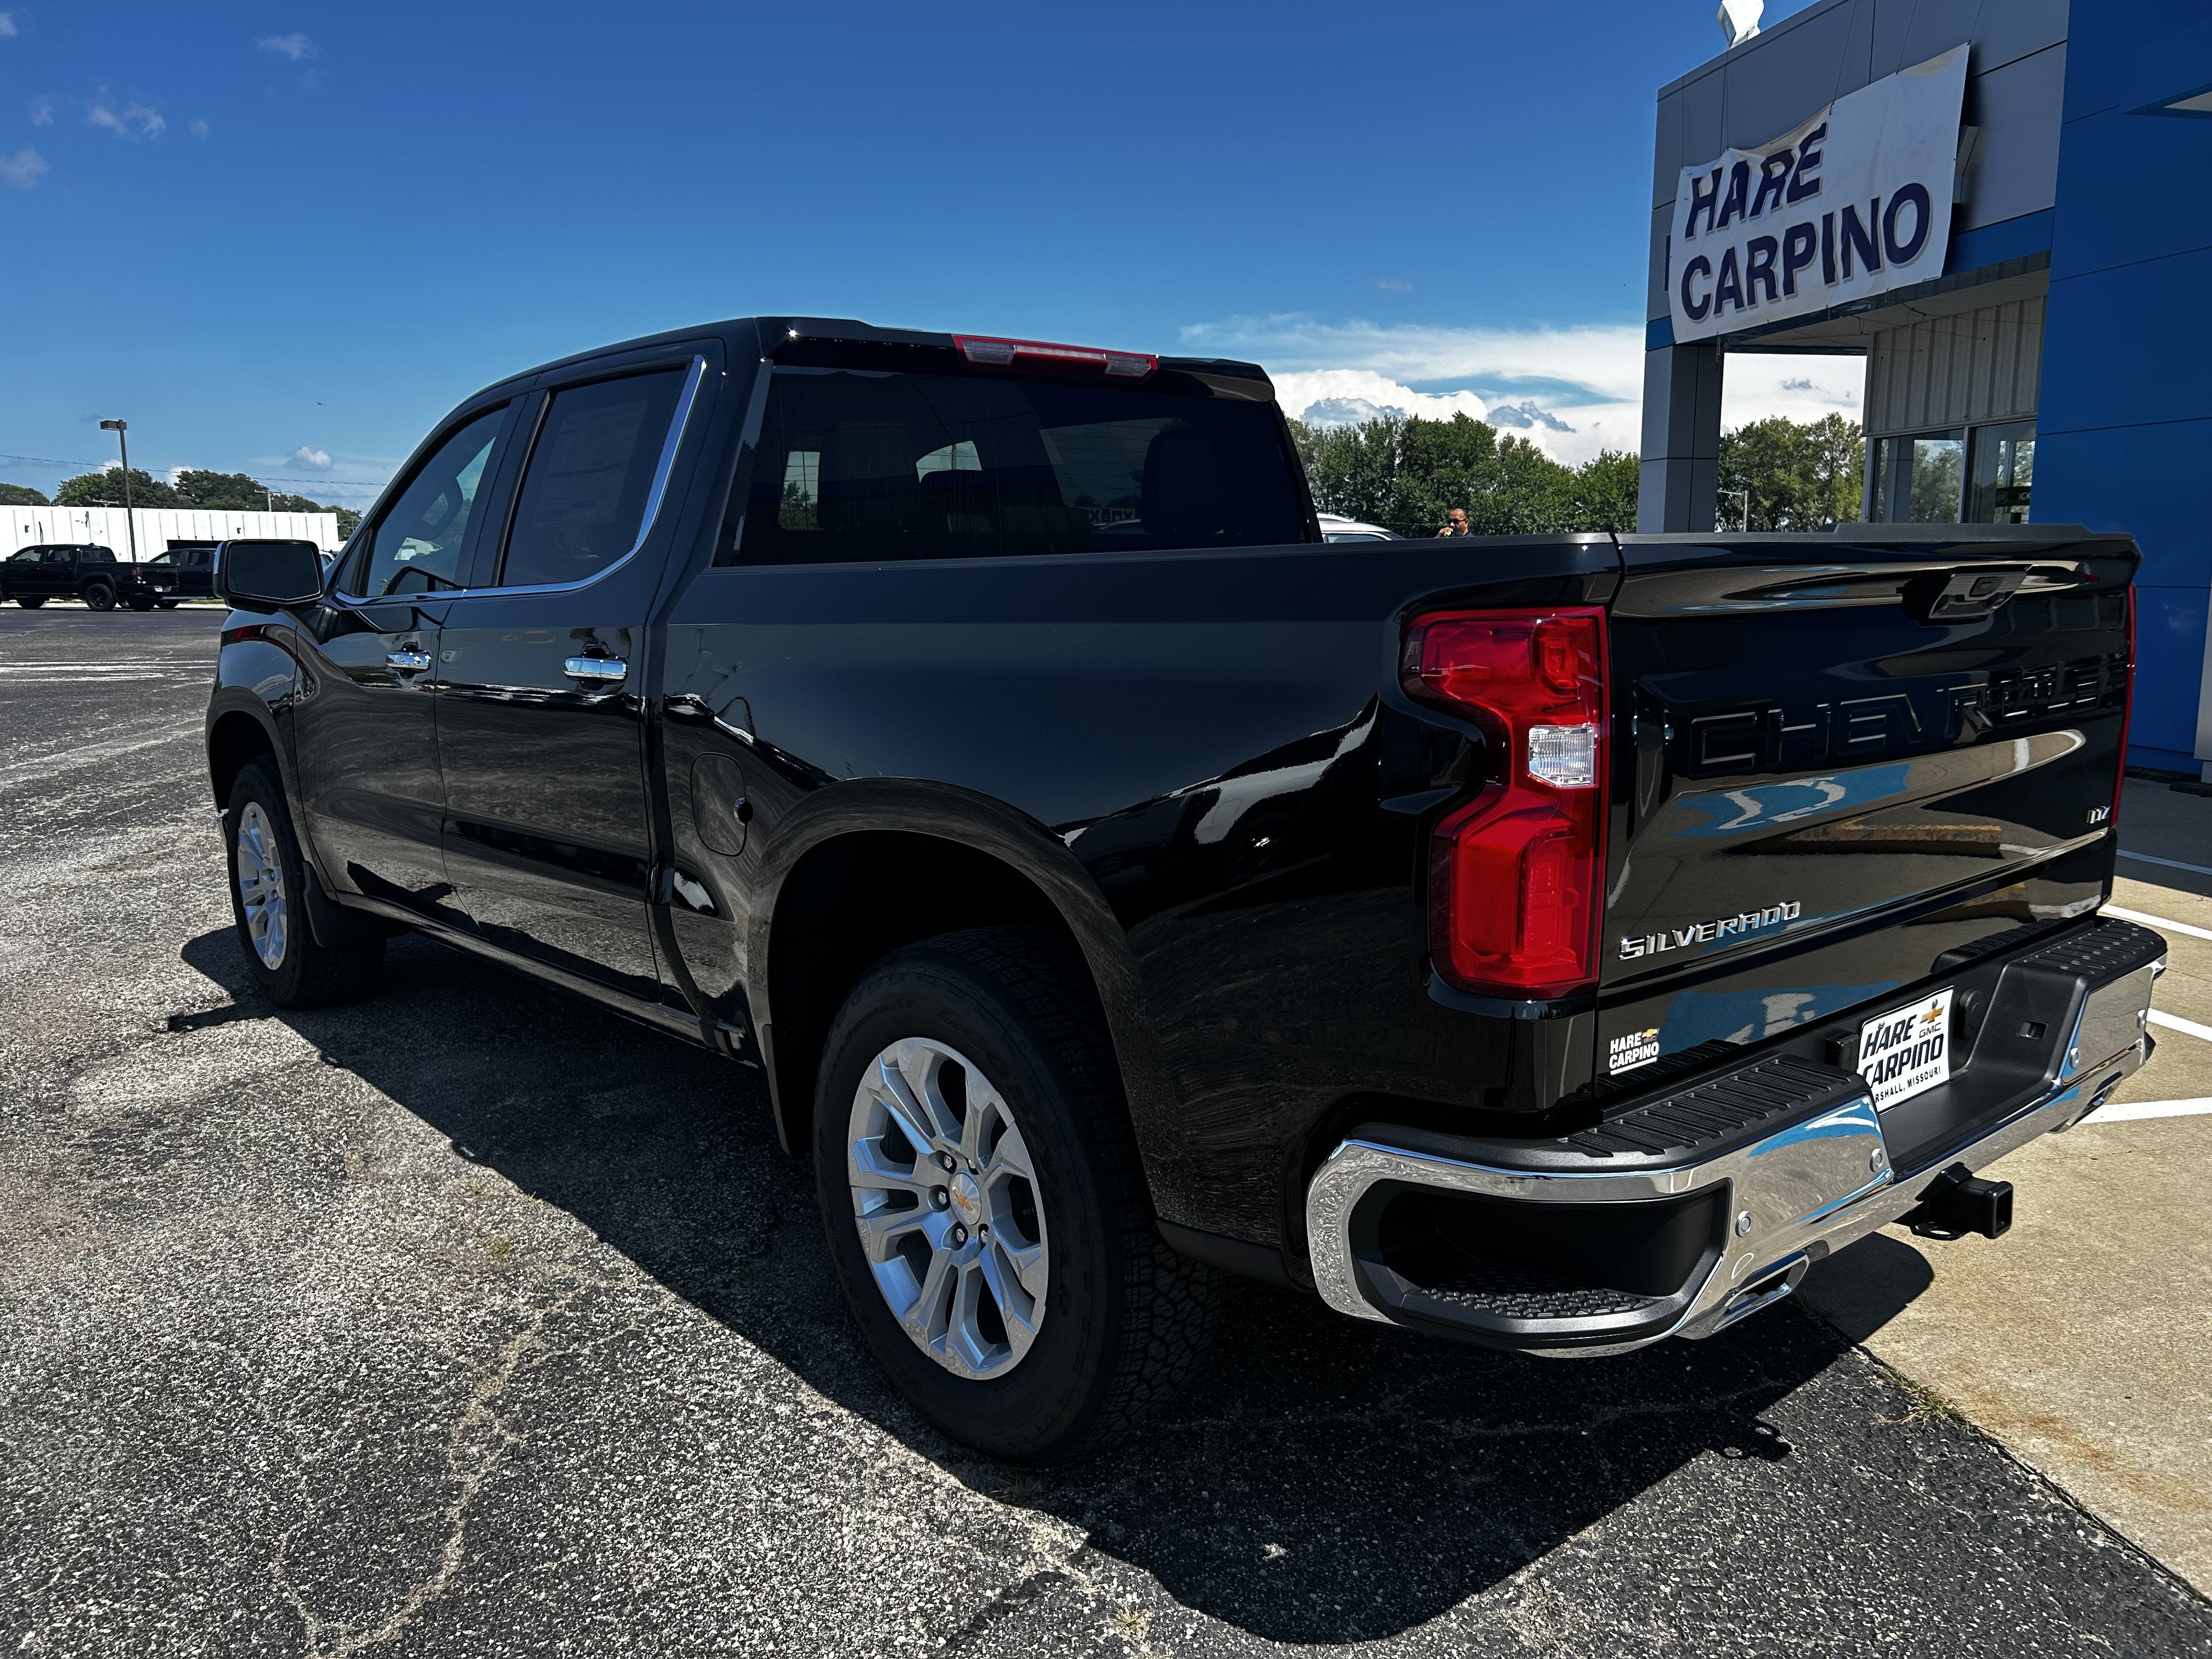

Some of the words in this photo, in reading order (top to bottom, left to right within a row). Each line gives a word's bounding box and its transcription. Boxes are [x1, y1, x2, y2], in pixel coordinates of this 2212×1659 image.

[1684, 121, 1828, 239] HARE
[1681, 182, 1932, 321] CARPINO
[1618, 900, 1801, 960] SILVERADO
[1610, 1032, 1642, 1054] HARE
[1861, 1014, 1917, 1060] HARE
[1919, 1022, 1942, 1039] GMC
[1609, 1041, 1660, 1069] CARPINO
[1875, 1083, 1905, 1103] RSHALL,
[1907, 1065, 1941, 1088] MISSOURI
